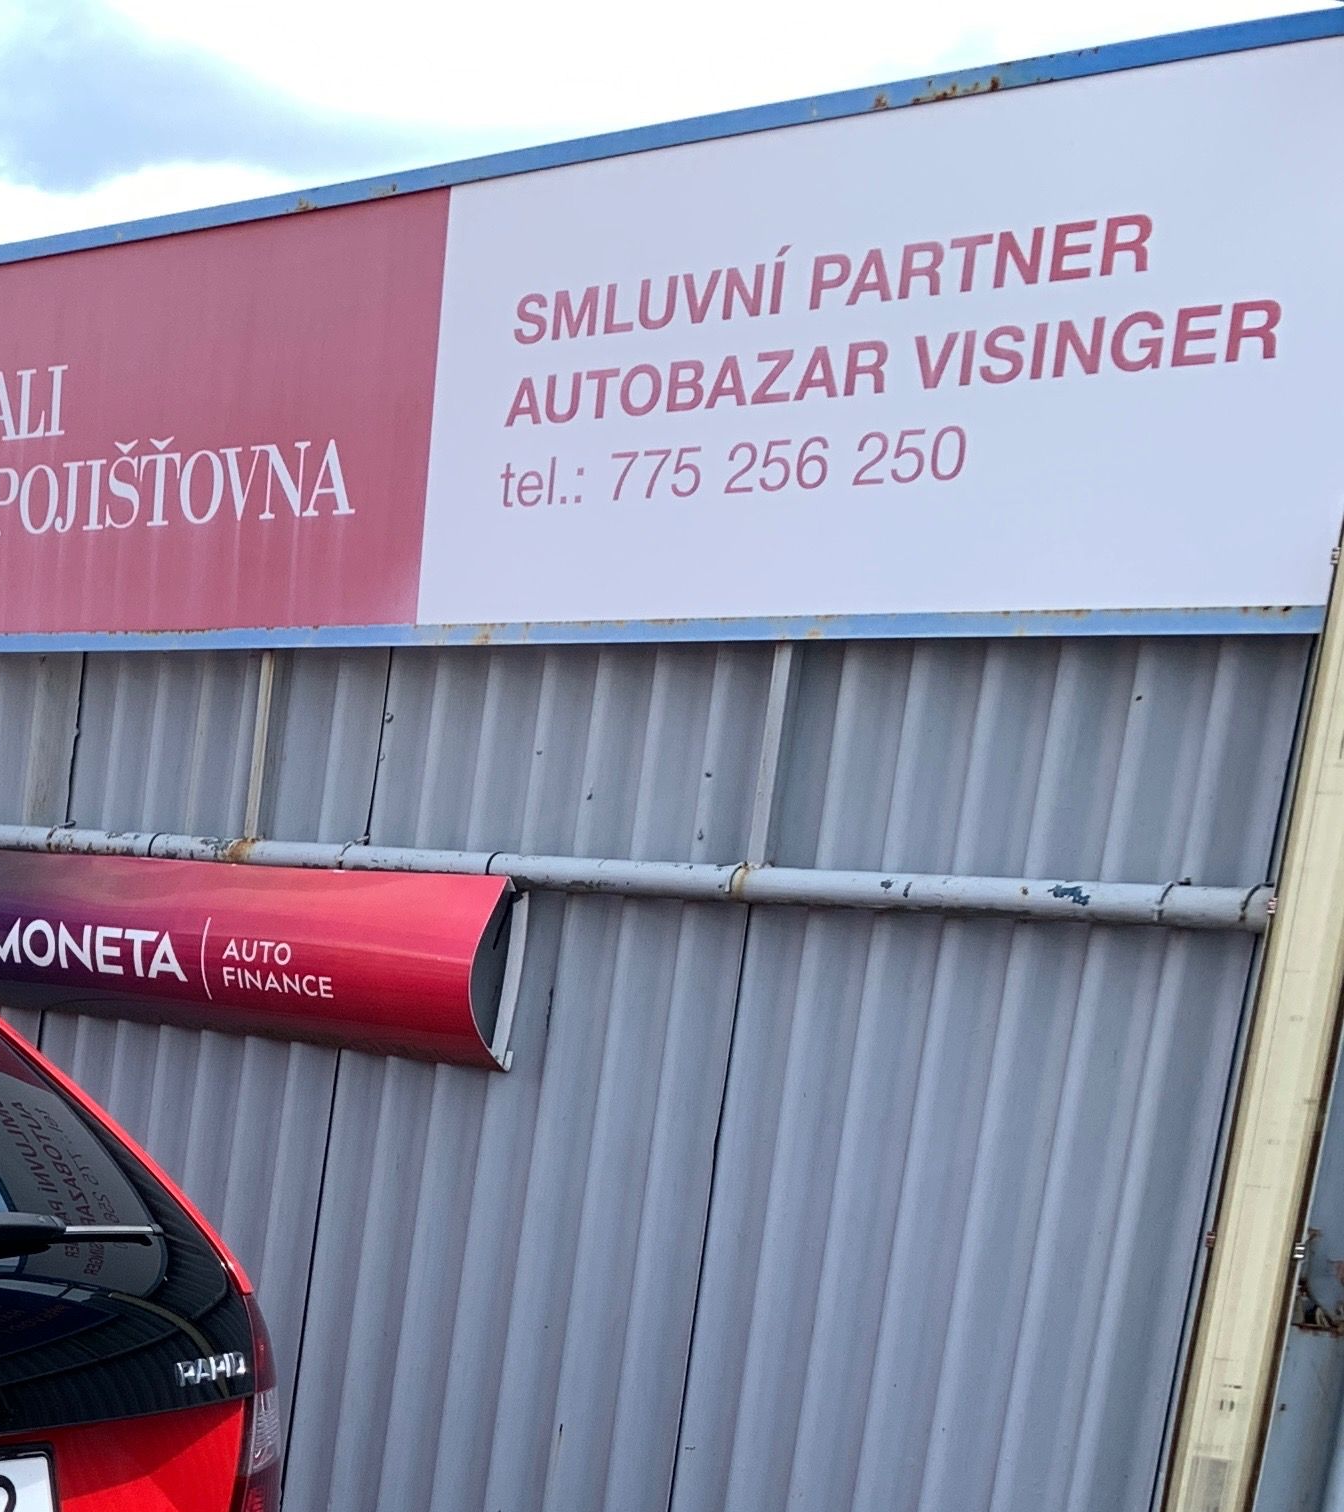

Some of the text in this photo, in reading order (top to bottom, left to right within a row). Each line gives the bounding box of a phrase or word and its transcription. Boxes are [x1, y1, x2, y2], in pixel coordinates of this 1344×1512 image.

[512, 213, 1153, 346] SMLUVNÍ PARTNER
[505, 298, 1283, 428] AUTOBAZAR VISINGER
[500, 425, 967, 507] tel.: 775 256 250
[222, 938, 292, 966] AUTO
[222, 966, 334, 999] FINANCE
